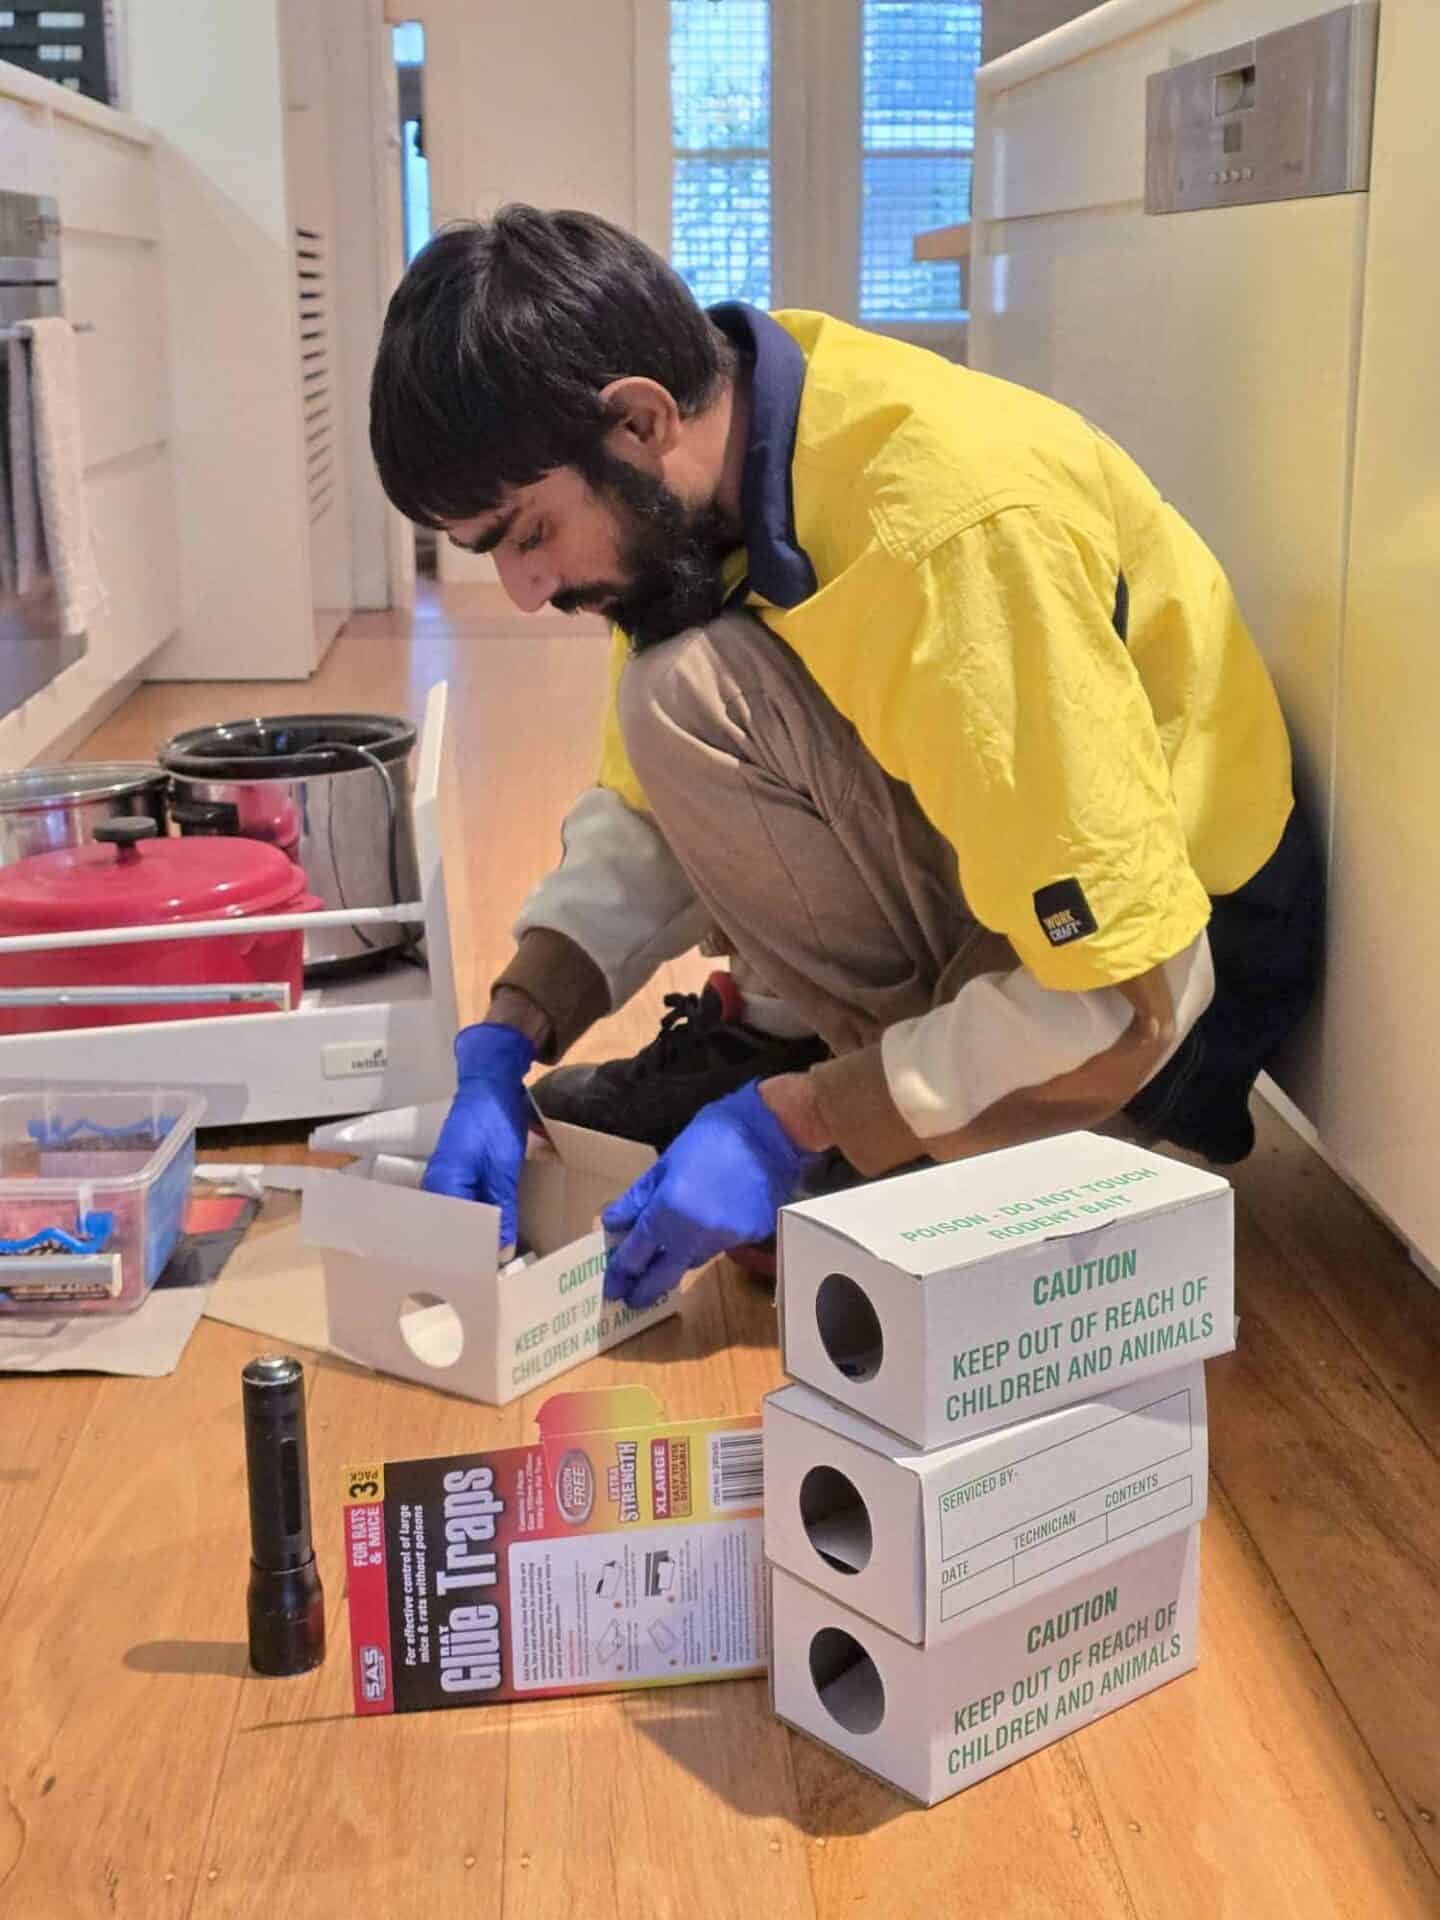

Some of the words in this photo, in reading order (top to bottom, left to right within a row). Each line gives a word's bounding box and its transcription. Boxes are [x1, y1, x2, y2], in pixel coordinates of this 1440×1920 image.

[1049, 922, 1080, 942] CRAFT
[900, 1211, 989, 1242] POISON
[1003, 1199, 1033, 1218] DO
[1034, 1187, 1085, 1209] NOT
[1083, 1167, 1158, 1195] TOUCH
[989, 1209, 1085, 1241] RODENT
[1083, 1193, 1131, 1217] BAIT
[1032, 1248, 1138, 1306] CAUTION
[514, 1322, 549, 1355] KEEP
[552, 1305, 578, 1336] OUT
[582, 1295, 599, 1319] OF
[952, 1341, 1010, 1381] KEEP
[1018, 1323, 1062, 1361] OUT
[1070, 1311, 1097, 1344] OF
[1104, 1289, 1175, 1332] REACH
[1183, 1276, 1209, 1306] OF
[512, 1338, 580, 1385] CHILDREN
[583, 1320, 610, 1345] AND
[945, 1360, 1061, 1422] CHILDREN
[1067, 1345, 1112, 1382] AND
[1119, 1311, 1214, 1366] ANIMALS
[350, 1472, 378, 1482] PACK
[350, 1482, 378, 1497] 3
[563, 1467, 574, 1509] POISON
[573, 1465, 586, 1507] FREE
[608, 1467, 620, 1500] EXTRA
[616, 1442, 639, 1521] STRENGTH
[654, 1445, 668, 1515] XLARGE
[942, 1475, 998, 1513] SERVICED
[1105, 1472, 1159, 1508] CONTENTS
[351, 1509, 366, 1539] RATS
[367, 1506, 381, 1547] MICE
[399, 1504, 412, 1534] large
[413, 1505, 426, 1549] poisons
[436, 1467, 504, 1595] Traps
[1014, 1511, 1077, 1551] TECHNICIAN
[354, 1542, 368, 1567] FOR
[369, 1552, 382, 1564] &
[400, 1536, 411, 1550] of
[402, 1552, 413, 1593] control
[415, 1552, 427, 1595] without
[941, 1560, 970, 1585] DATE
[404, 1596, 416, 1644] effective
[416, 1599, 428, 1622] rats
[418, 1624, 429, 1634] &
[1026, 1586, 1119, 1655] CAUTION
[405, 1646, 416, 1665] For
[418, 1636, 430, 1662] mice
[440, 1604, 502, 1692] Glue
[954, 1691, 1005, 1736] KEEP
[1012, 1671, 1053, 1706] OUT
[1057, 1654, 1083, 1684] OF
[1088, 1623, 1149, 1669] REACH
[1154, 1602, 1178, 1636] OF
[364, 1649, 381, 1698] SAS
[947, 1711, 1049, 1776] CHILDREN
[1055, 1683, 1094, 1718] AND
[1099, 1634, 1182, 1697] ANIMALS
